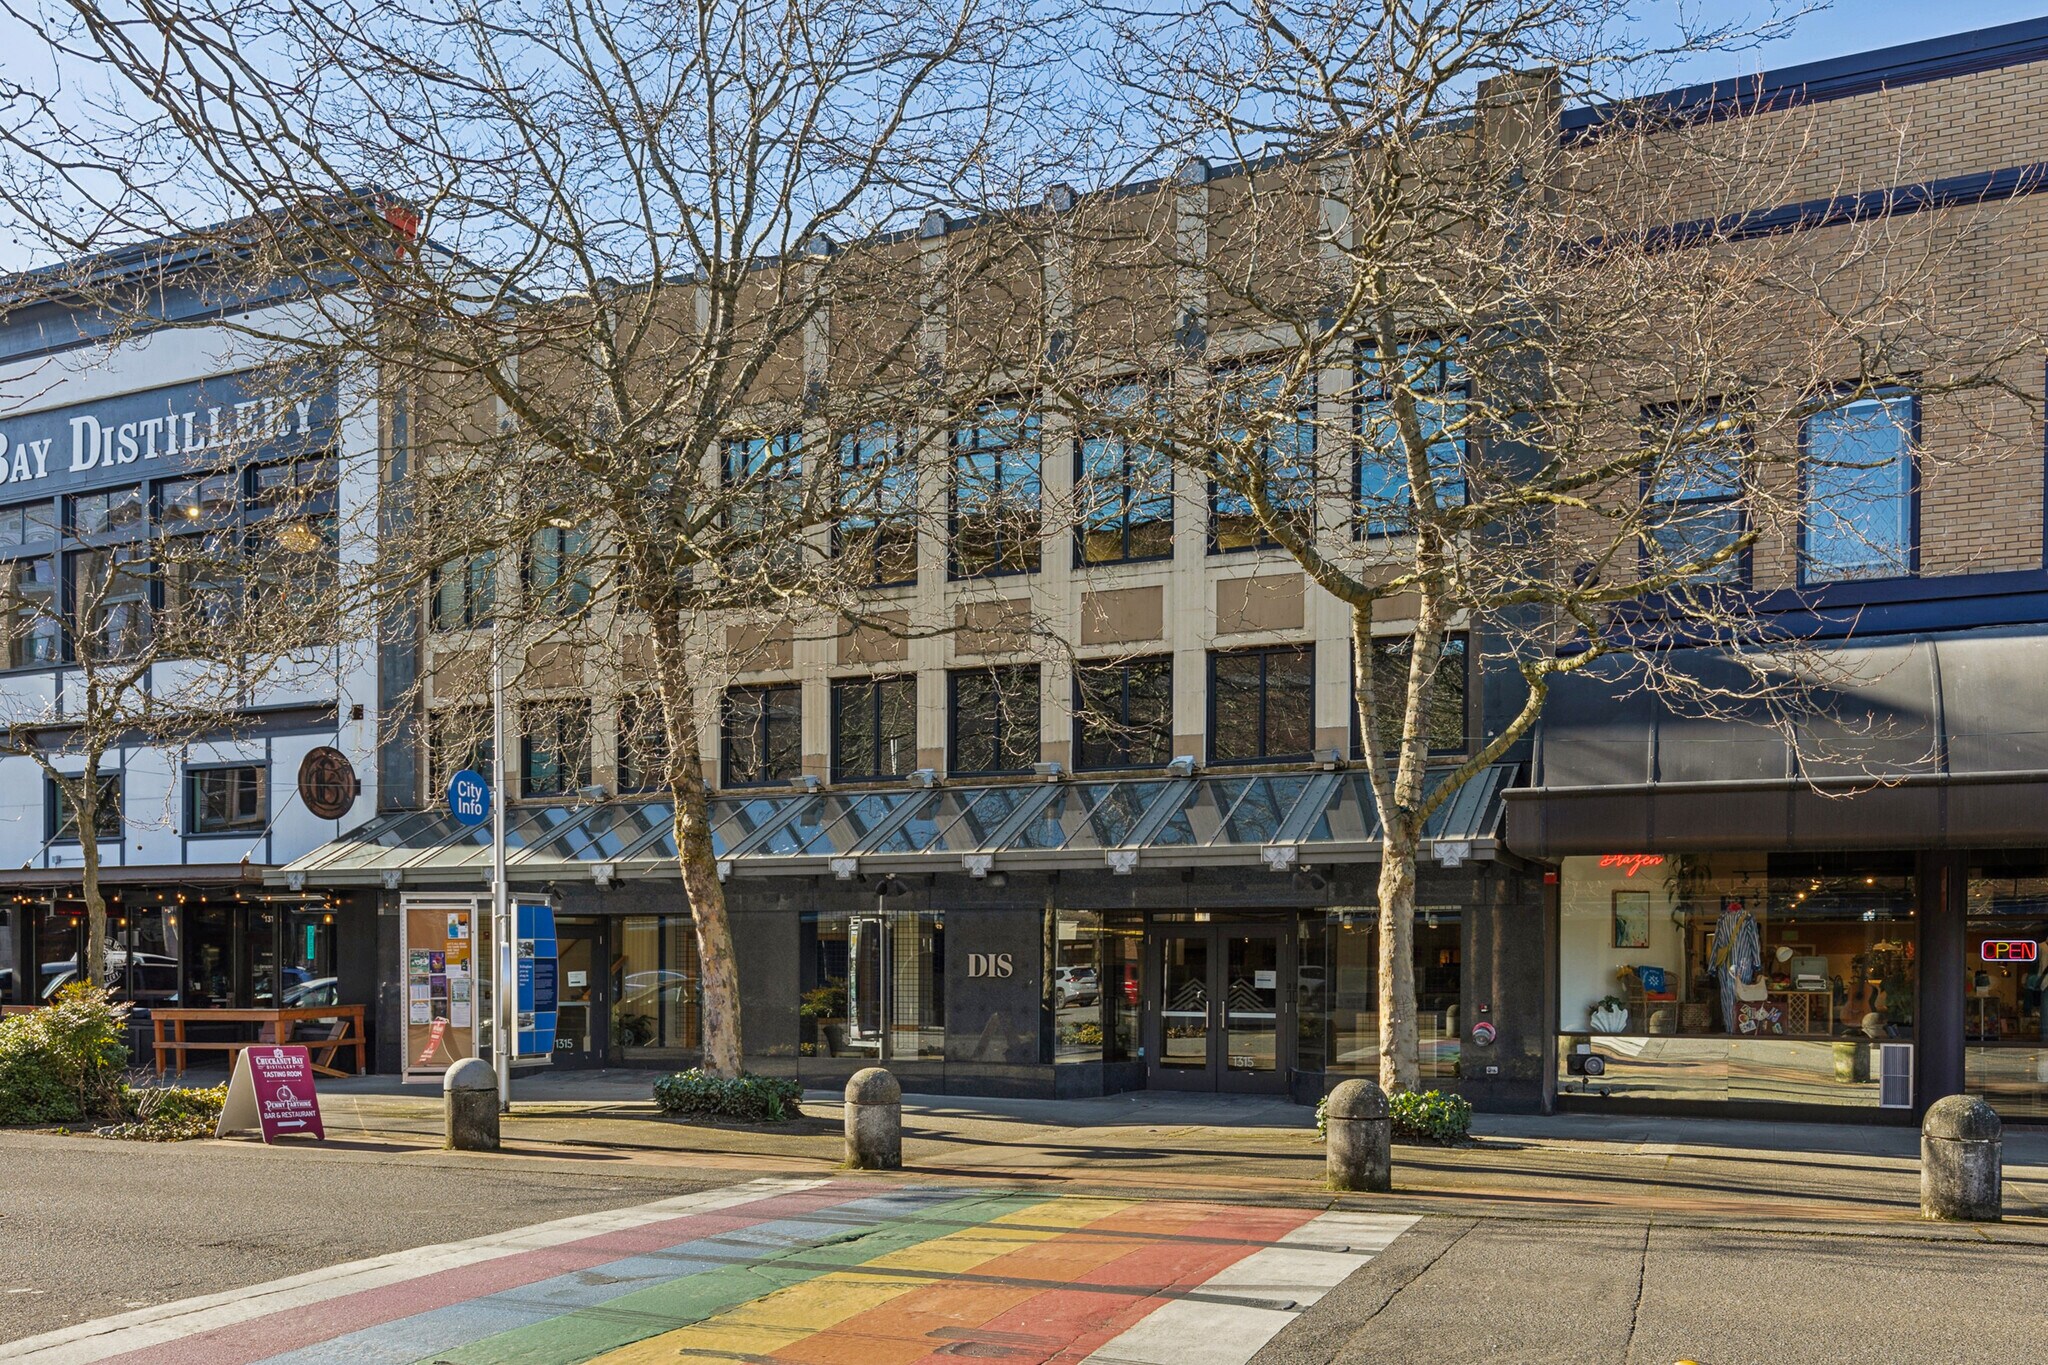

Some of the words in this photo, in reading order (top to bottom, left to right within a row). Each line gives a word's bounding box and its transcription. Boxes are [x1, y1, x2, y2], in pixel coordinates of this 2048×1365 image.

[457, 780, 483, 803] City
[458, 797, 483, 816] Info
[1983, 942, 2036, 960] OPEN
[967, 953, 1013, 978] DIS
[555, 1038, 573, 1049] 1315
[292, 1056, 303, 1064] BAY
[1232, 1055, 1254, 1068] 1315
